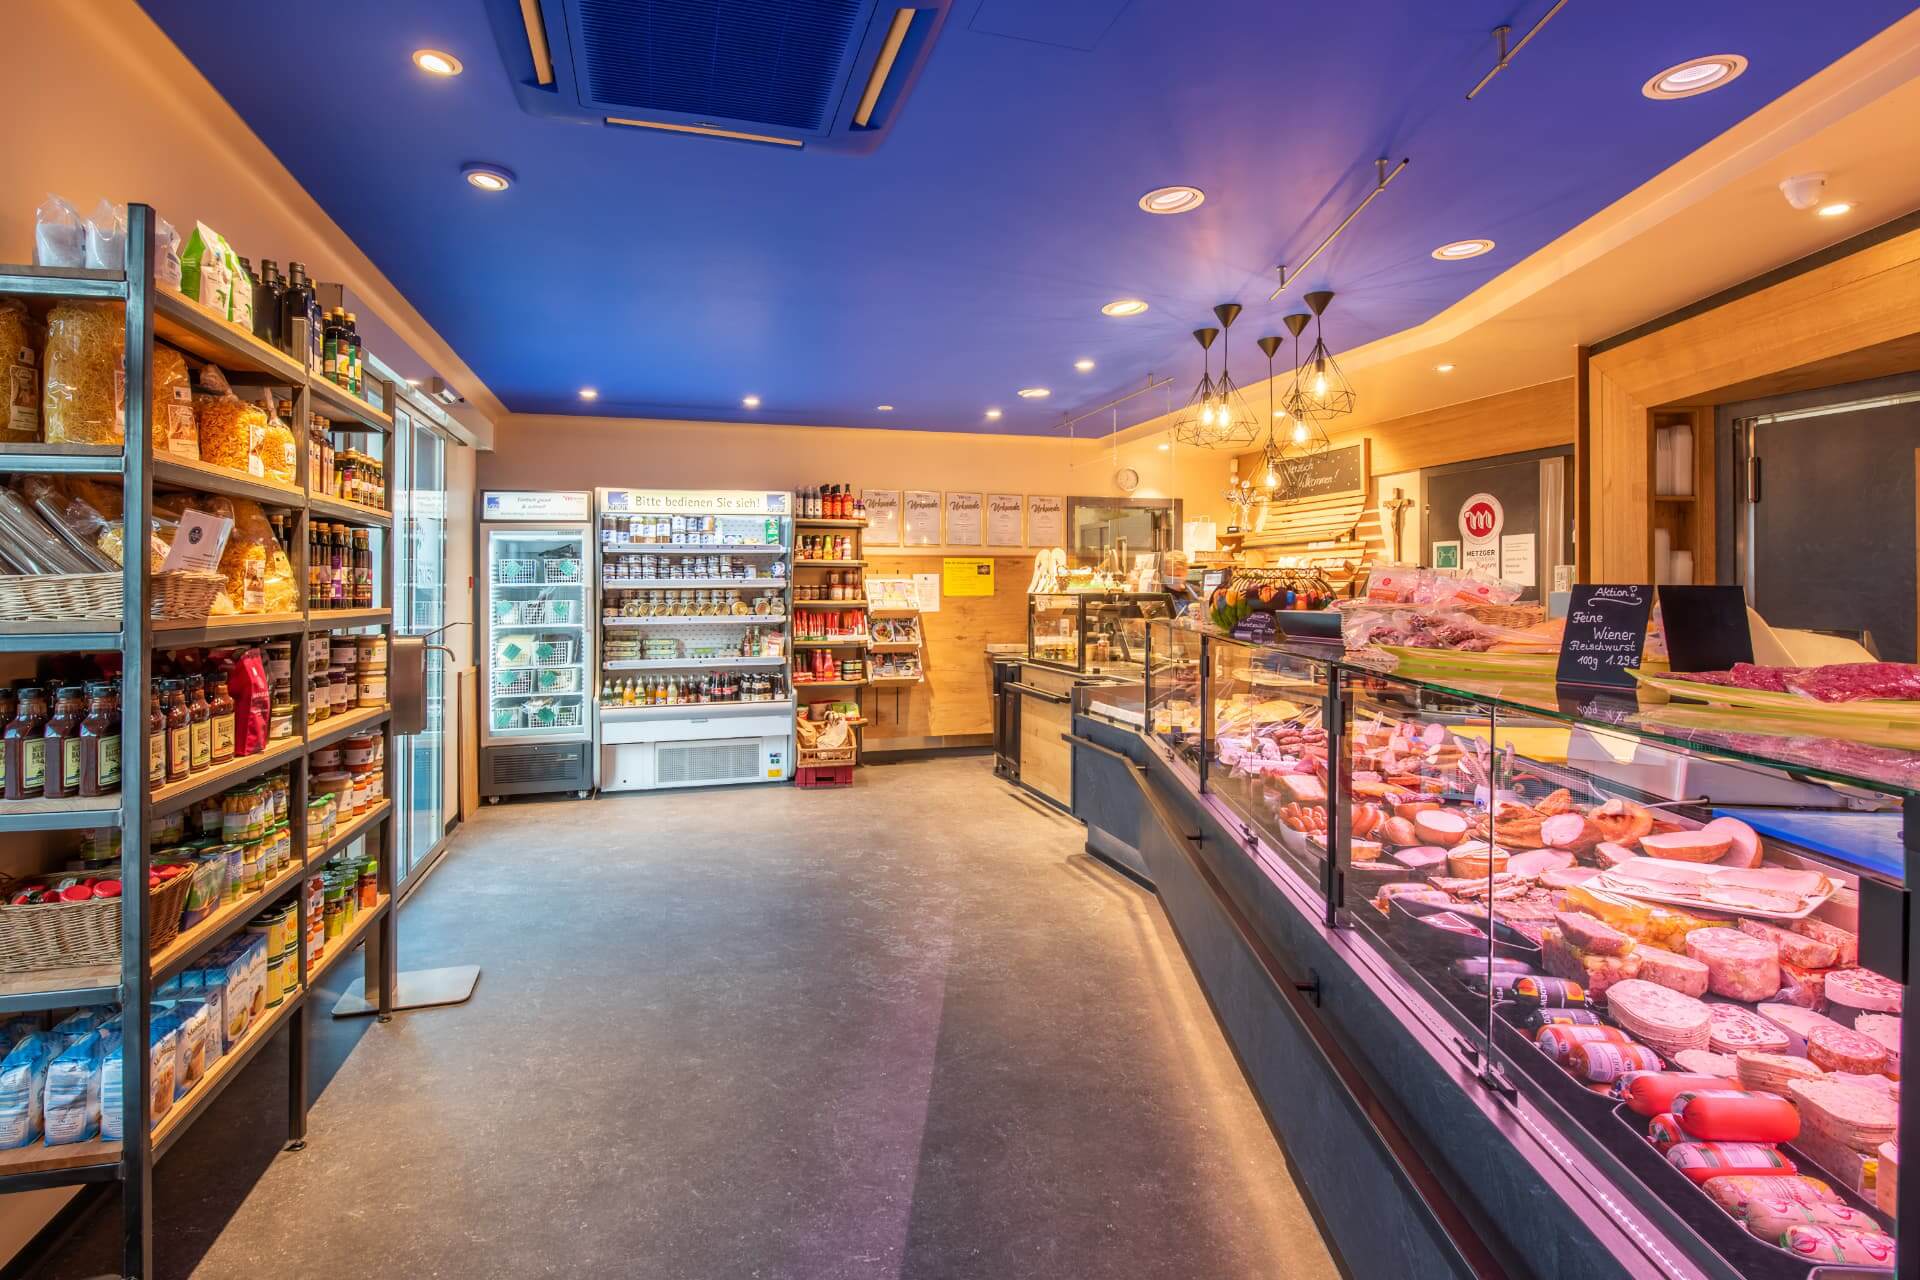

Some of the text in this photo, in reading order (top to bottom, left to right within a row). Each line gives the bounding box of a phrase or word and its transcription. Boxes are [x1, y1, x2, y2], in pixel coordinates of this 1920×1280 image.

[635, 496, 760, 508] Bitte bedienen Sie sich!
[864, 498, 898, 509] Urkunde
[907, 500, 938, 511] Urkunde
[949, 500, 980, 511] Urkunde
[991, 502, 1021, 512] Urkunde
[1031, 503, 1060, 514] Urkunde
[1594, 586, 1638, 597] Aktion!
[1572, 611, 1604, 624] Feine
[1593, 626, 1636, 641] Wiener
[1568, 640, 1636, 652] Fleischwurst
[1577, 654, 1640, 671] 100g 1.29€
